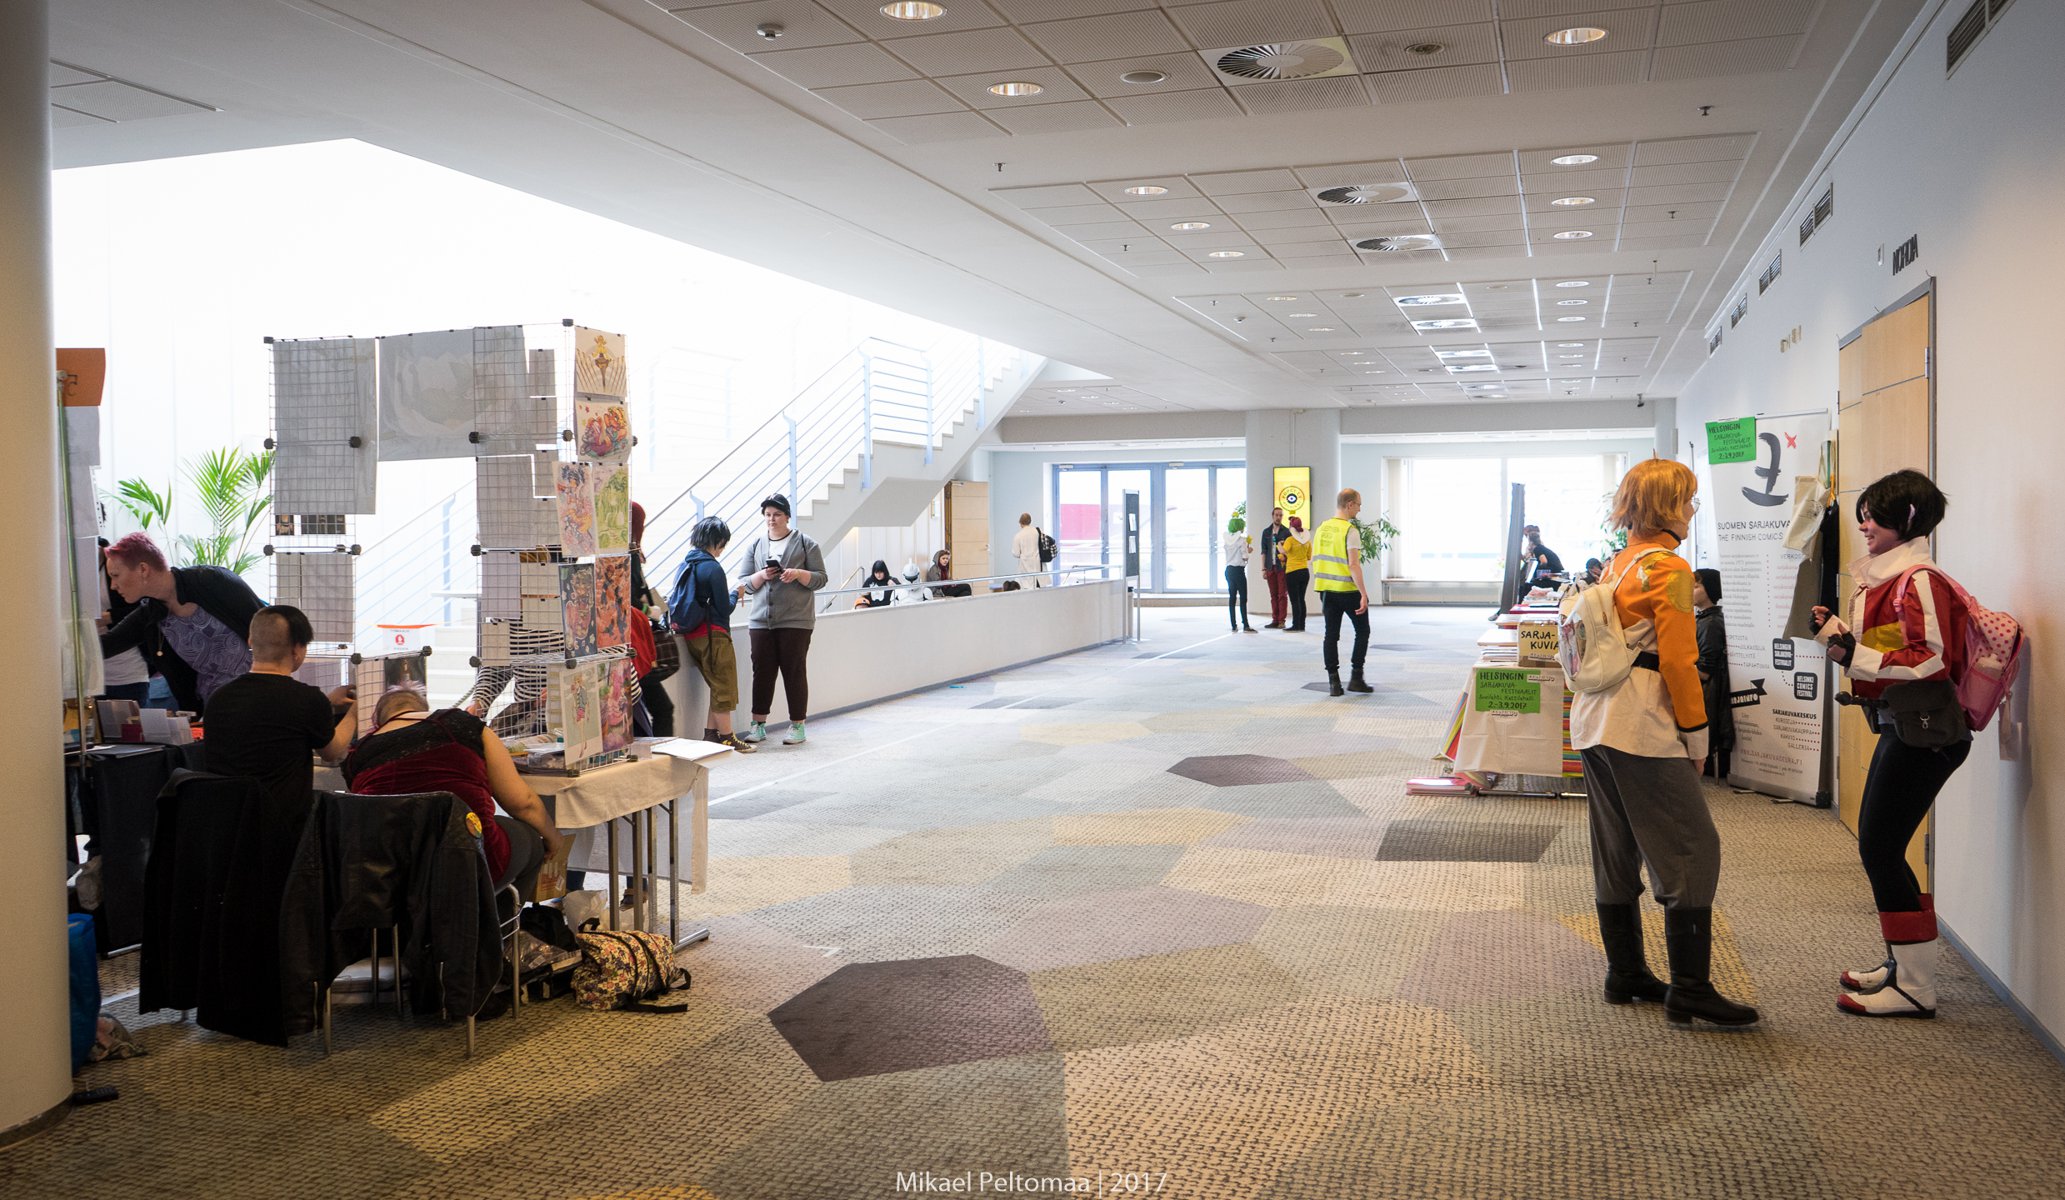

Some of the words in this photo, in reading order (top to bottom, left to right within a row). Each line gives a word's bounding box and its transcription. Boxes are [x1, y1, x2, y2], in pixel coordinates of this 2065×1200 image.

[1717, 521, 1746, 530] SUOMEN
[1731, 533, 1757, 541] FINNISH
[1758, 532, 1784, 540] COMICS
[1521, 630, 1556, 639] SARJA-
[1530, 641, 1559, 650] KUVIA
[1480, 671, 1524, 681] HELSINGIN
[1772, 708, 1817, 719] SARJAKUVAKESKUS
